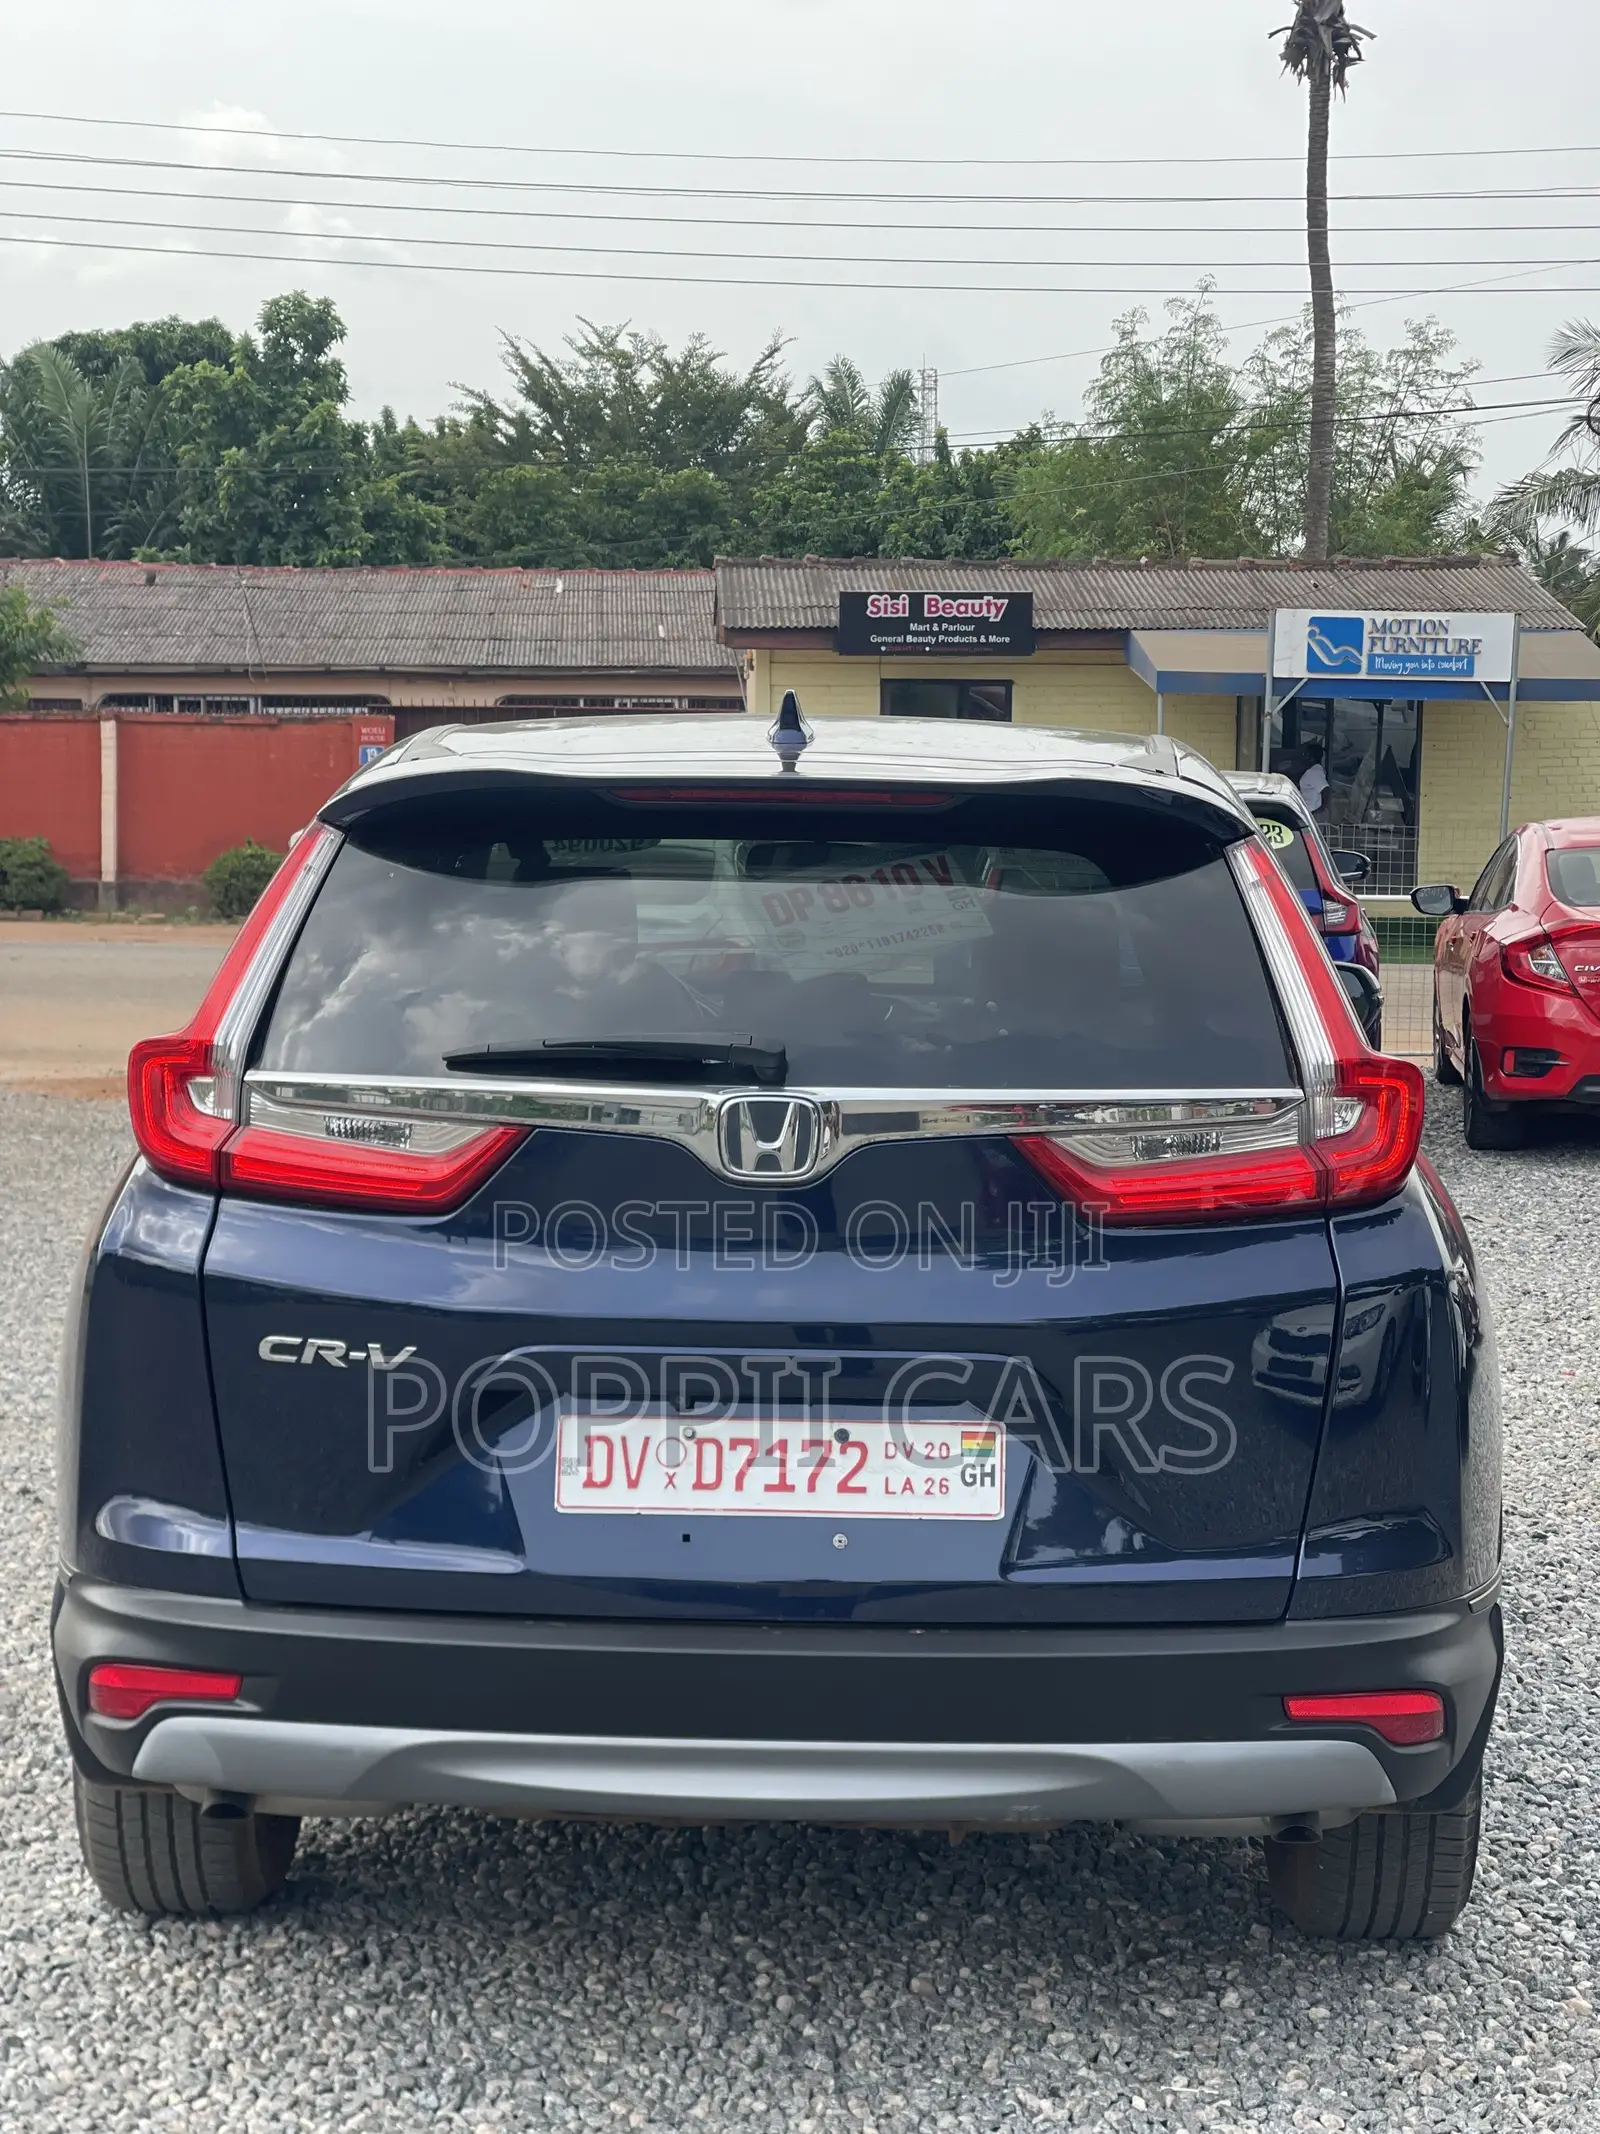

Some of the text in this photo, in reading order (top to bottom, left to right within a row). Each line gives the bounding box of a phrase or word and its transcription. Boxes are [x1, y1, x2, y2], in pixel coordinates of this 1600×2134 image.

[866, 594, 1008, 621] Sisi Beauty
[910, 623, 975, 632] Mart & Parlour
[1368, 618, 1450, 635] MOTION
[870, 635, 1010, 645] General Beauty Products & More
[1368, 636, 1483, 655] FURNITURE
[1375, 656, 1469, 674] Moving you into comfort
[760, 886, 815, 928] DP
[952, 898, 977, 912] GH
[258, 1335, 418, 1371] CR-V
[884, 1442, 951, 1461] DV 20
[582, 1435, 651, 1490] DV
[692, 1437, 870, 1495] D7172
[960, 1463, 997, 1488] GH
[884, 1476, 950, 1495] LA 26
